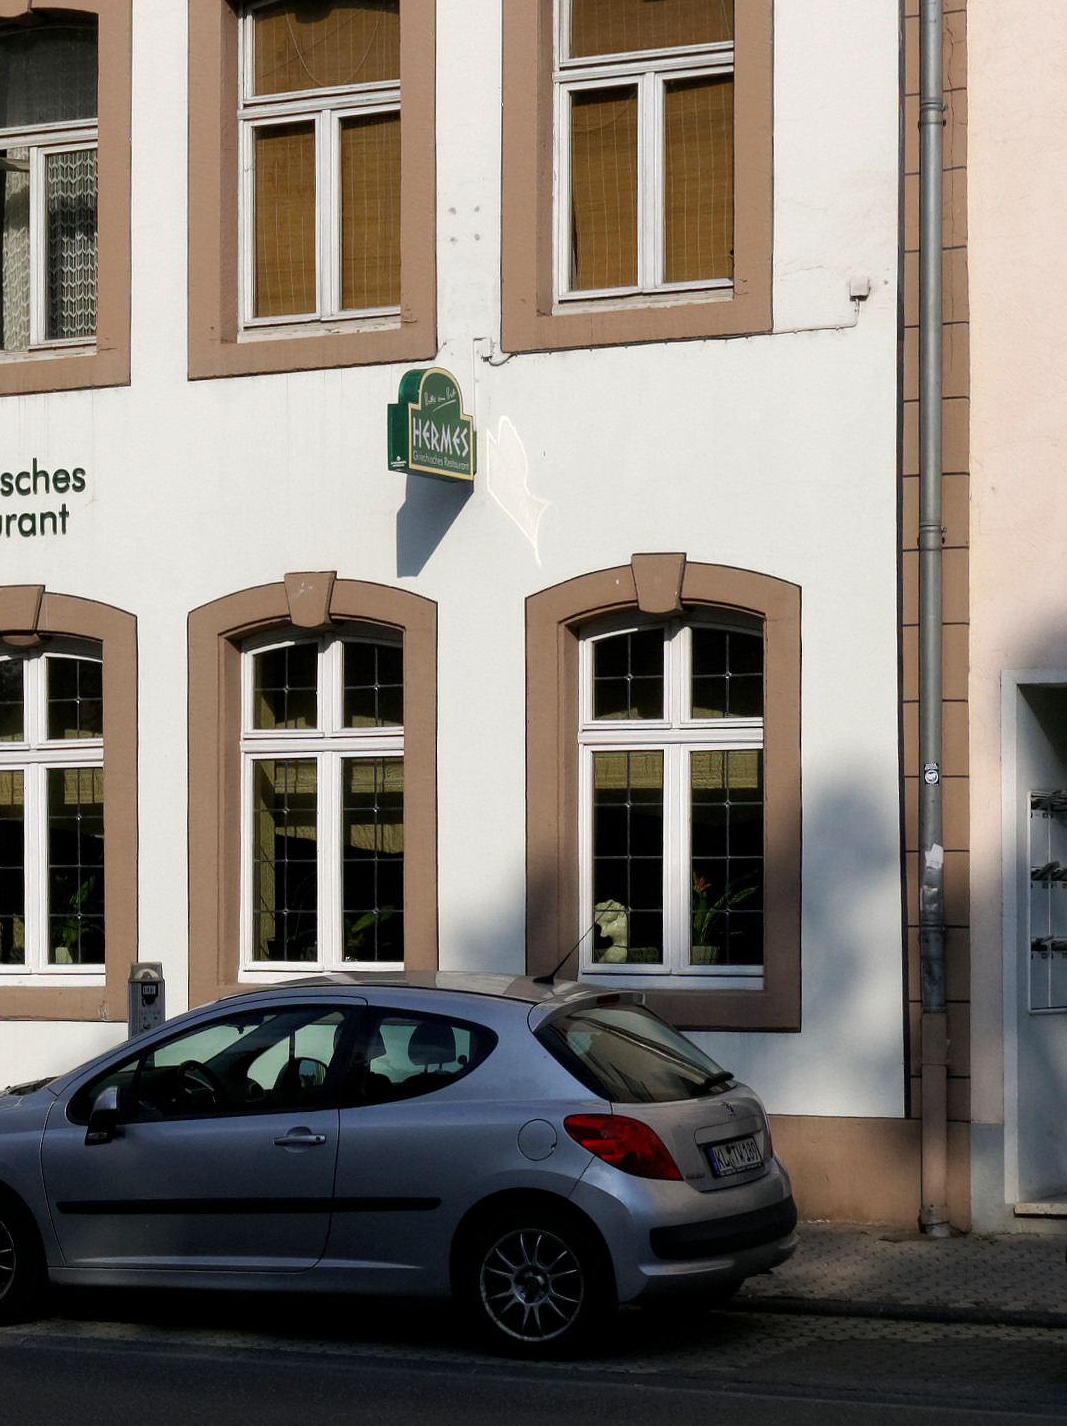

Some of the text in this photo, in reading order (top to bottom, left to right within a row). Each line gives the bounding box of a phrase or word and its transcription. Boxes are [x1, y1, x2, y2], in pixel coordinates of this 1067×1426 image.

[413, 417, 469, 457] HERMES
[413, 450, 443, 465] Griechisches
[444, 456, 470, 471] Restaurant
